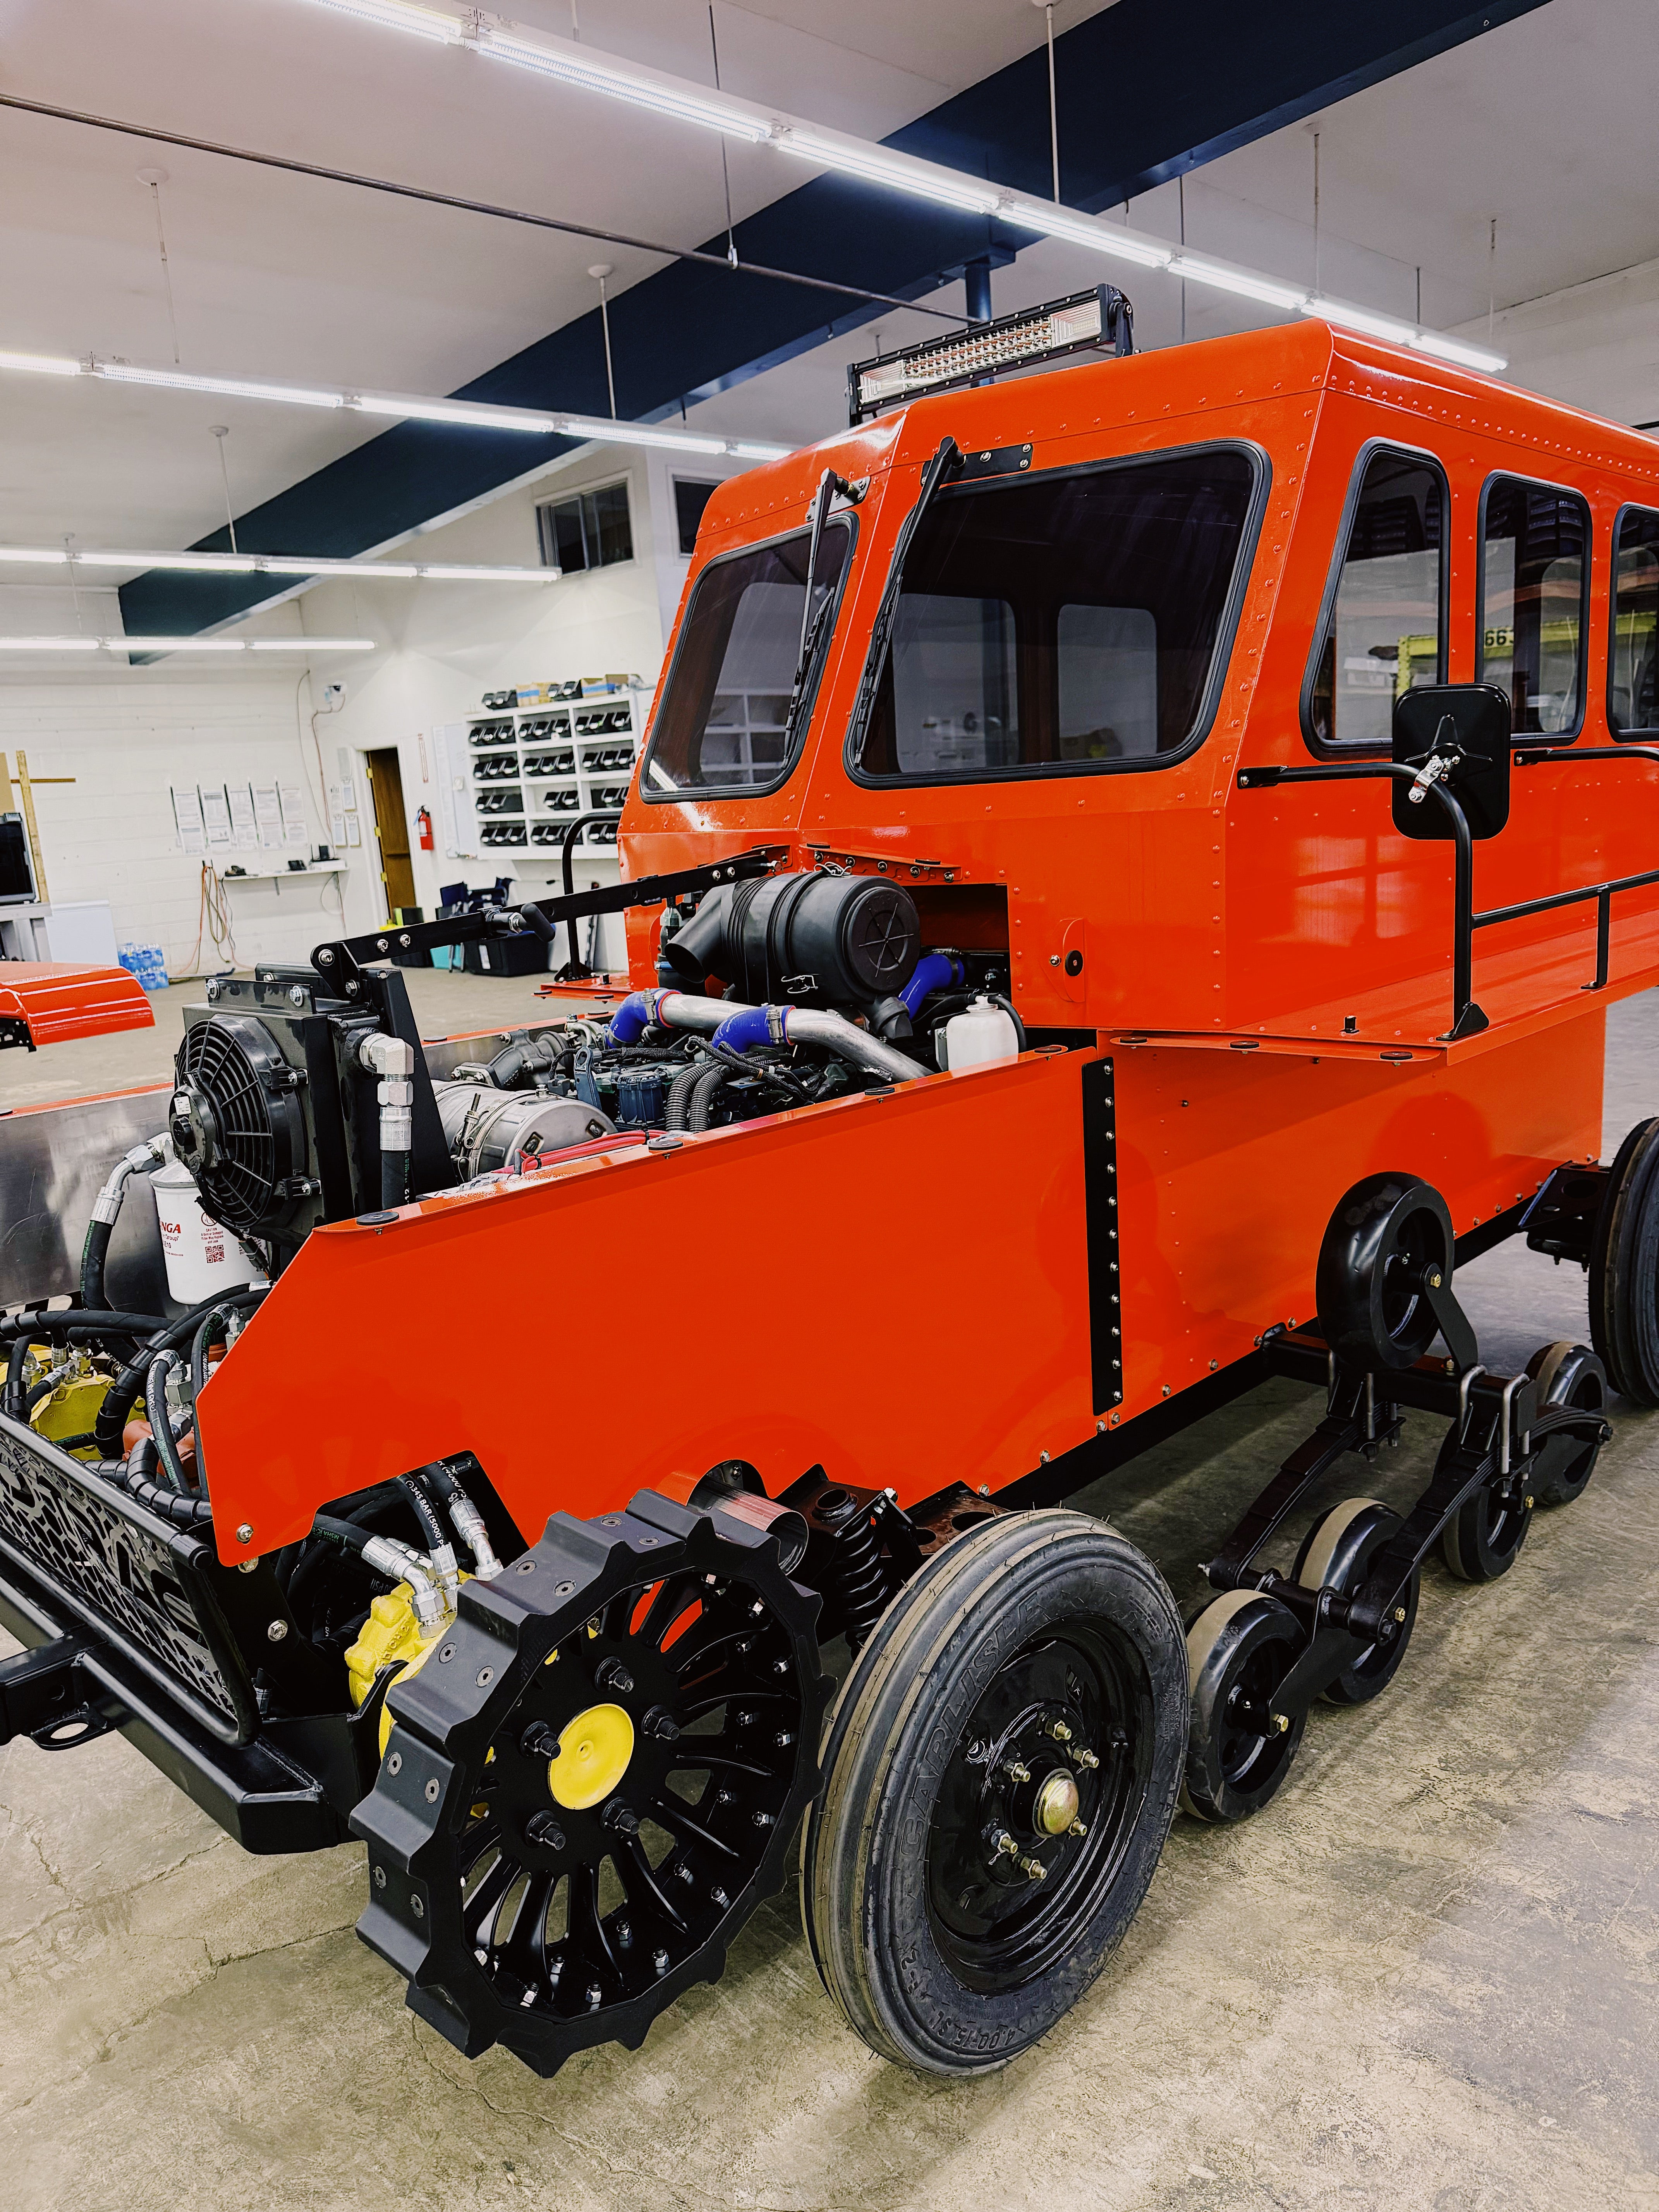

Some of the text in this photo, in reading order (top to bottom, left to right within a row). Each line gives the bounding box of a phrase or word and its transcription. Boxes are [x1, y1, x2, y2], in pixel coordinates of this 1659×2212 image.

[1485, 629, 1513, 646] 66
[411, 1486, 423, 1500] 345
[419, 1499, 433, 1516] BAR
[428, 1515, 442, 1539] (5000
[324, 1530, 339, 1540] MSHA
[900, 1590, 1040, 1856] CARLISLE
